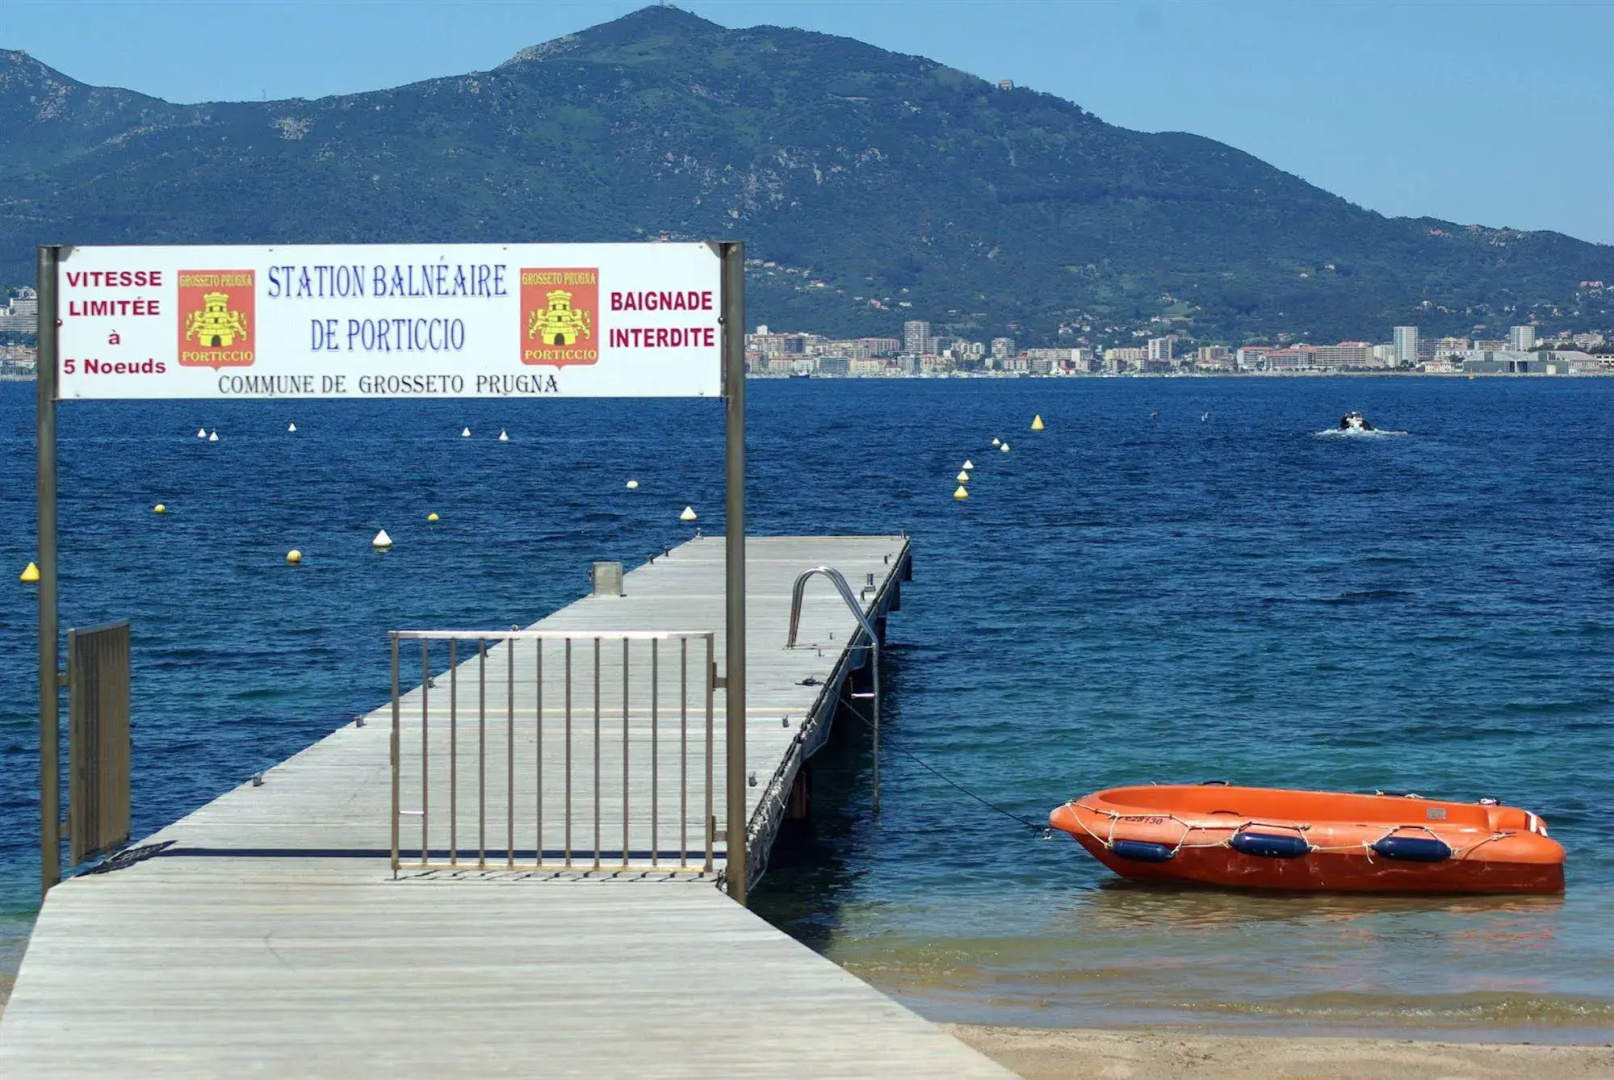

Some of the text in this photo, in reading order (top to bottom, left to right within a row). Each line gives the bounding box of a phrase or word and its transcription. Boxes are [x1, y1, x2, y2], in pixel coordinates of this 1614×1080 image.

[66, 271, 163, 288] VITESSE
[179, 274, 220, 287] GROSSETO
[267, 256, 508, 299] STATION BALNÉAIRE
[522, 272, 596, 285] GROSSETO PRUGNA
[68, 296, 161, 317] LIMITÉE
[610, 290, 713, 312] BAIGNADE
[108, 329, 121, 346] à
[310, 317, 466, 352] DE PORTICCIO
[609, 327, 715, 348] INTERDITE
[181, 350, 254, 362] PORTICCIO
[524, 349, 597, 360] PORTICCIO
[63, 357, 167, 375] 5 Noeuds
[218, 374, 560, 396] COMMUNE DE GROSSETO PRUGNA
